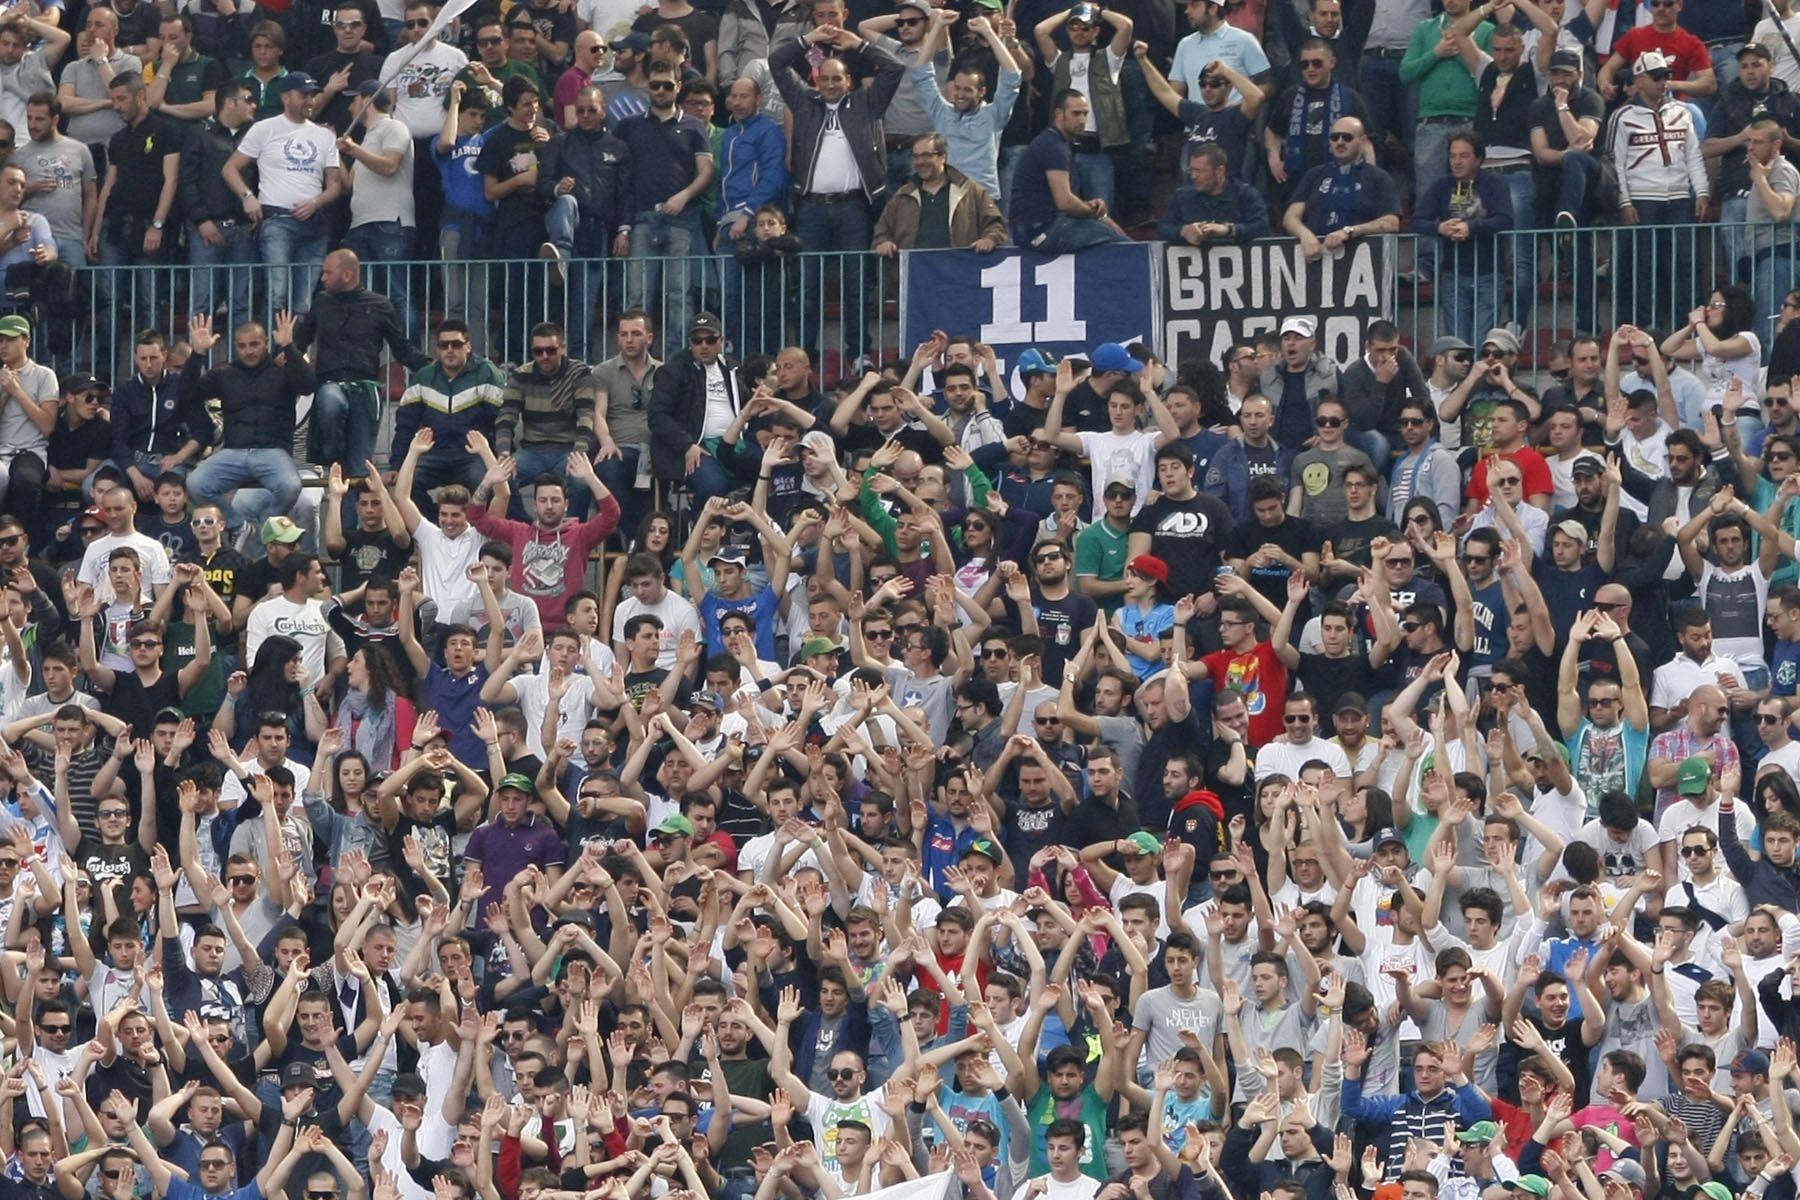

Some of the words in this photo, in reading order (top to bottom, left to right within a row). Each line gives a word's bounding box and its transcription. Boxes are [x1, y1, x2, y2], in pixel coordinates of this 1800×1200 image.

[970, 253, 1077, 345] 11
[1166, 242, 1379, 312] GRINTA
[274, 616, 327, 637] Carlsberg
